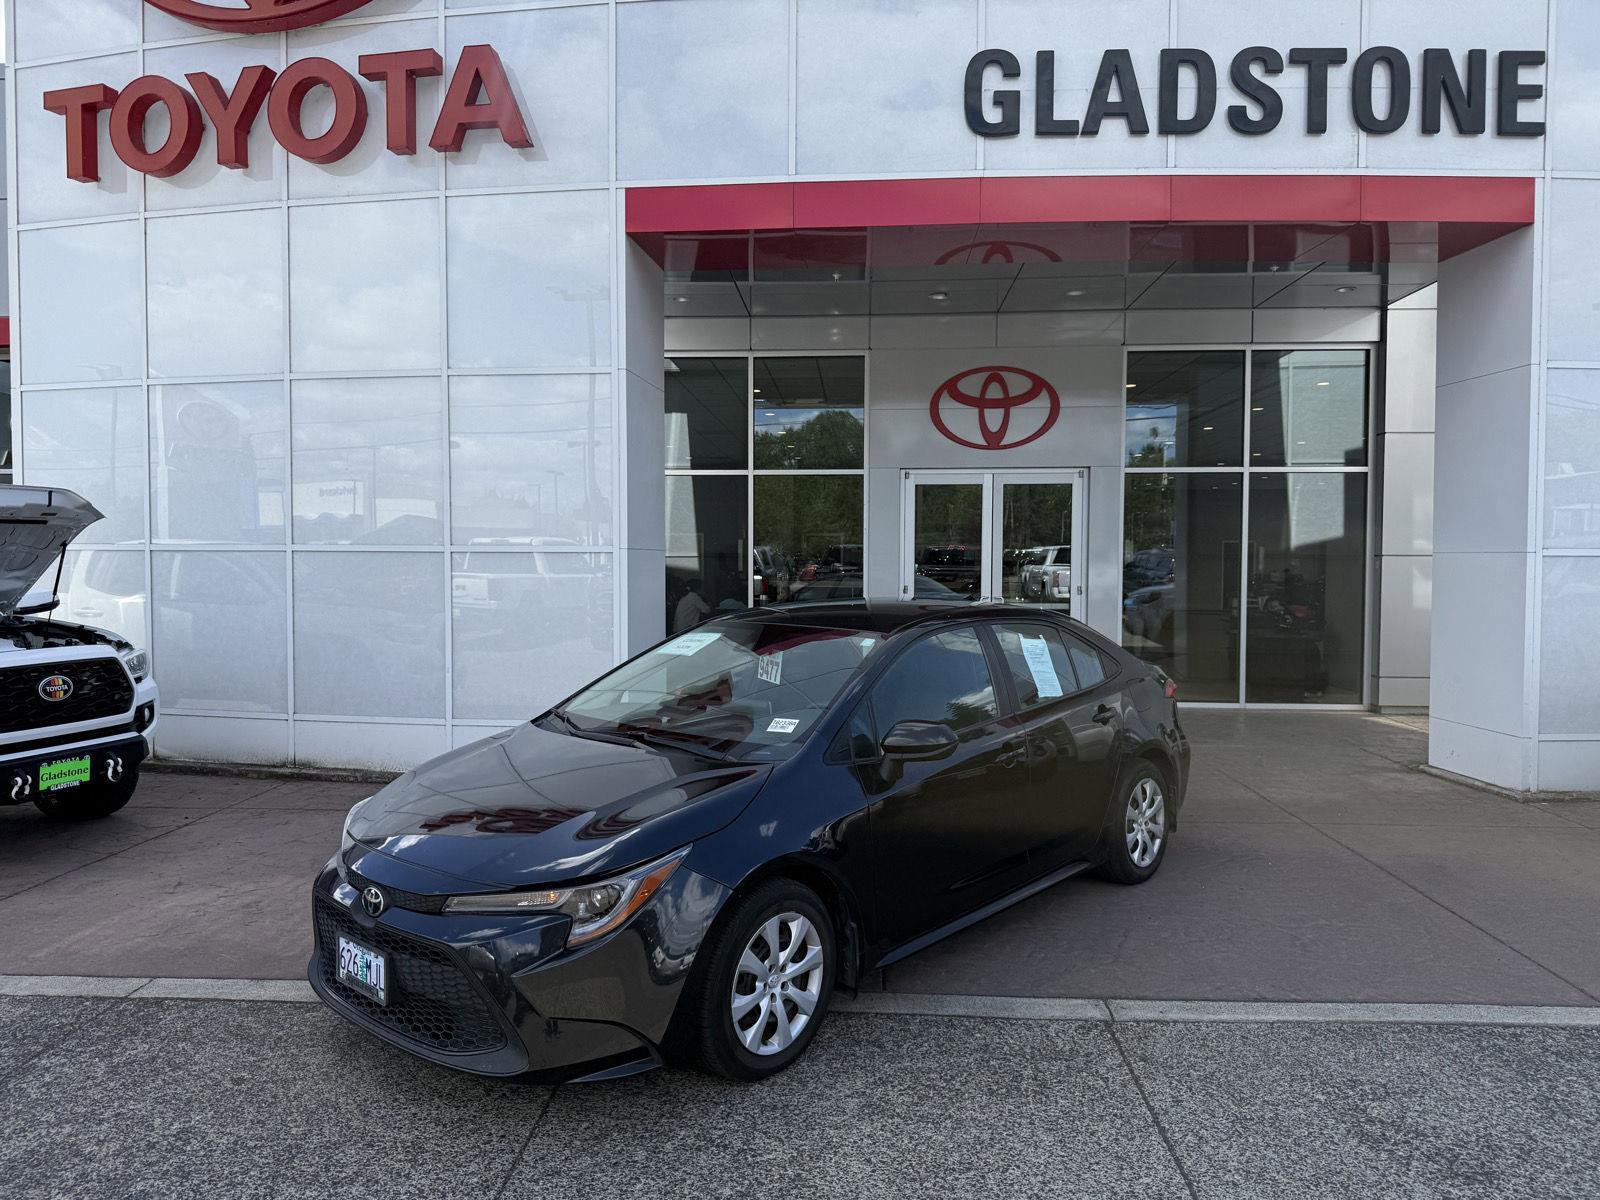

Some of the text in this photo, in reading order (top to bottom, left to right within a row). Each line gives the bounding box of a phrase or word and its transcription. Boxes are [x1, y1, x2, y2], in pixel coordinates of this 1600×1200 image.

[964, 46, 1546, 137] GLADSTONE
[44, 44, 534, 183] TOYOTA
[46, 684, 68, 693] TOYOTA
[52, 757, 80, 765] TOYOTA
[41, 767, 88, 782] Gladstone
[51, 780, 80, 791] GLADSTONE
